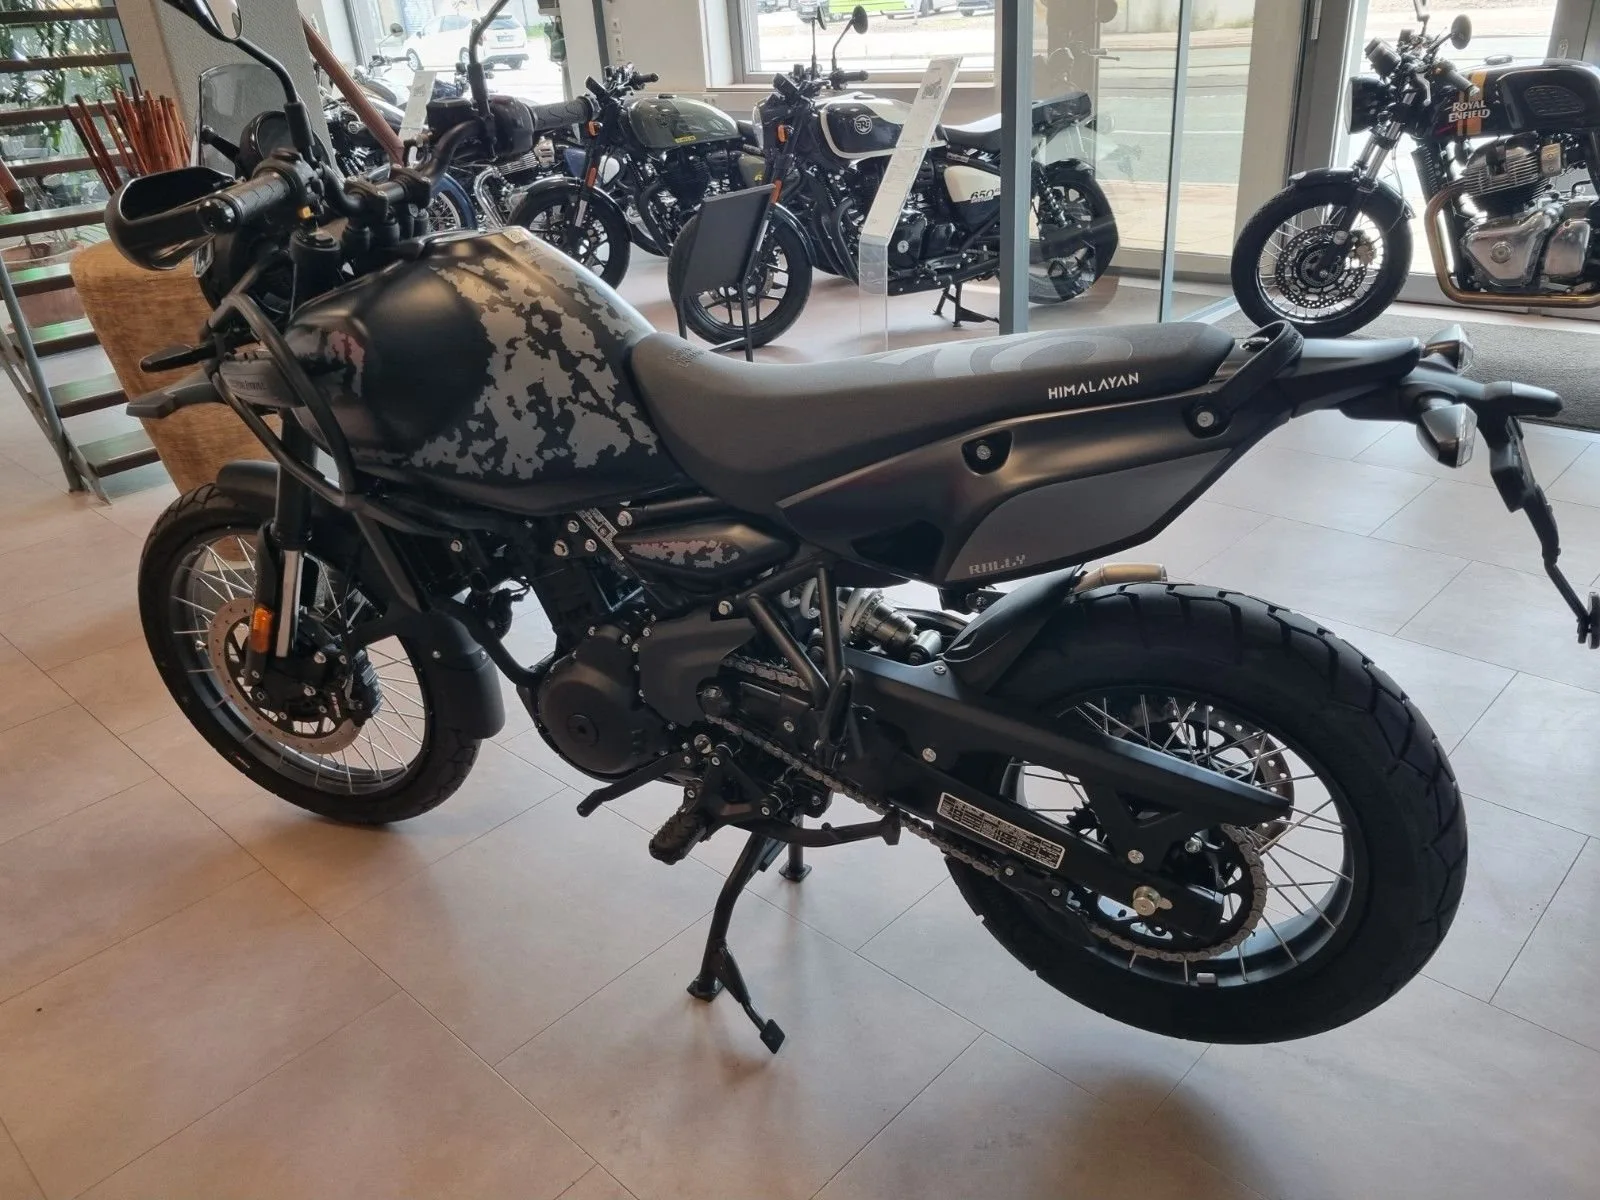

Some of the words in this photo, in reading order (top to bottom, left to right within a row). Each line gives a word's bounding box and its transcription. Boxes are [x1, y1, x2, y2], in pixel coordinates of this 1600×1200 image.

[1452, 100, 1486, 111] ROYAL
[1448, 109, 1490, 122] ENFIELD
[1047, 371, 1139, 400] HIMALAYAN
